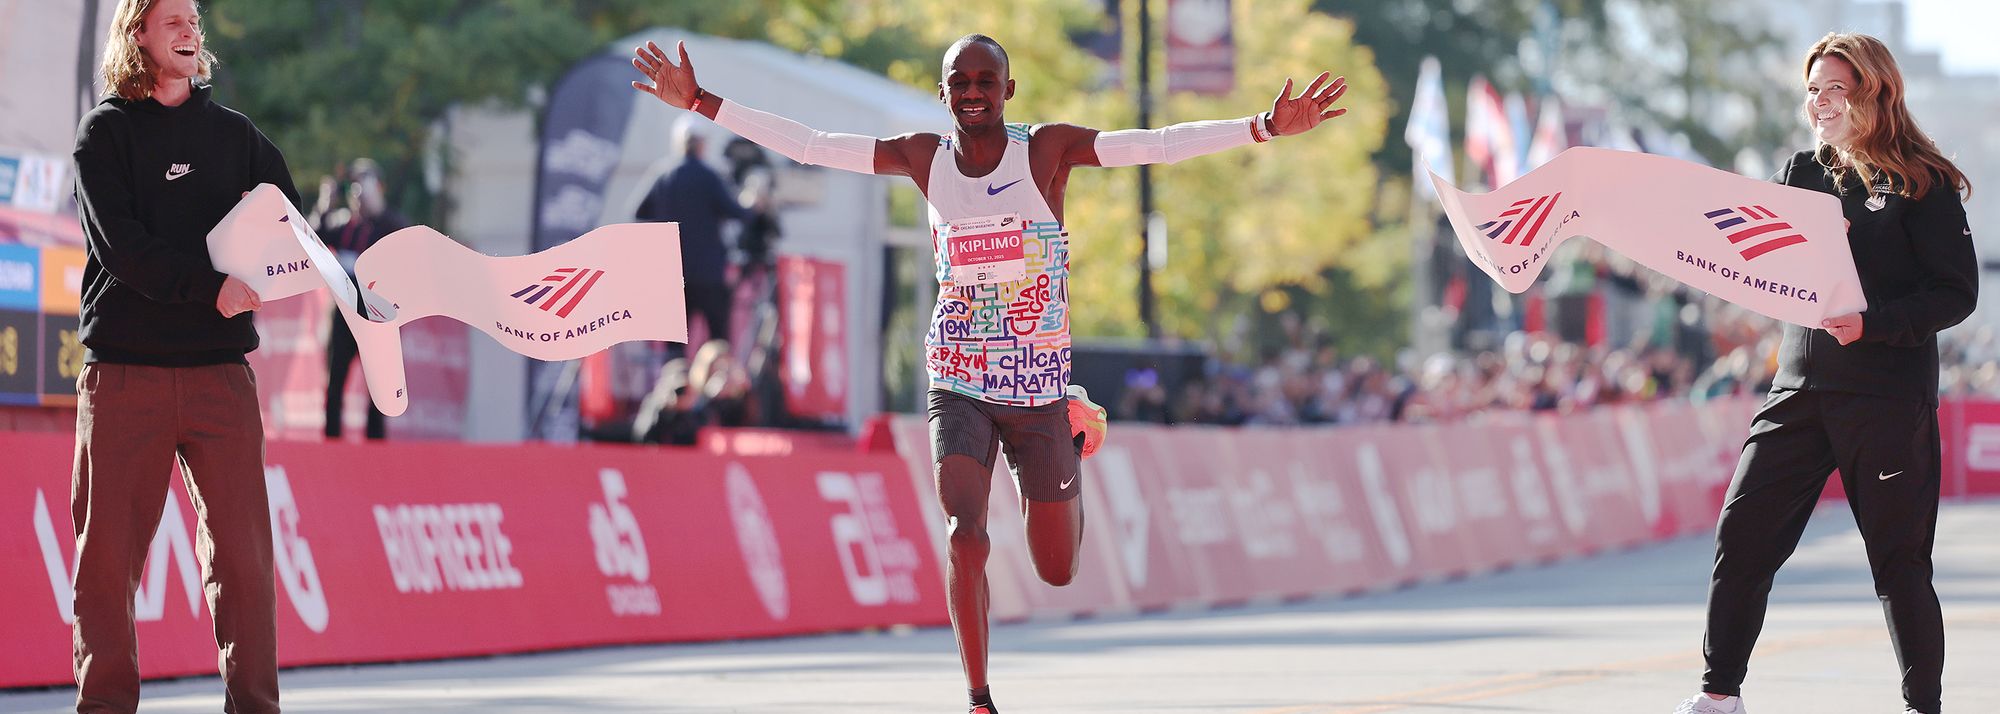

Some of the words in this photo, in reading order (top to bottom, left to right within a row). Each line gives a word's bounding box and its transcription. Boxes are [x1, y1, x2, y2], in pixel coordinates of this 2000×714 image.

[170, 163, 191, 174] RUN
[950, 242, 956, 257] J
[960, 235, 1020, 254] KIPLIMO
[266, 259, 310, 277] BANK
[1510, 260, 1529, 274] OF
[1677, 250, 1717, 273] BANK
[1721, 267, 1740, 281] OF
[1743, 275, 1818, 303] AMERICA
[496, 321, 535, 341] BANK
[540, 331, 560, 342] OF
[565, 309, 632, 339] AMERICA
